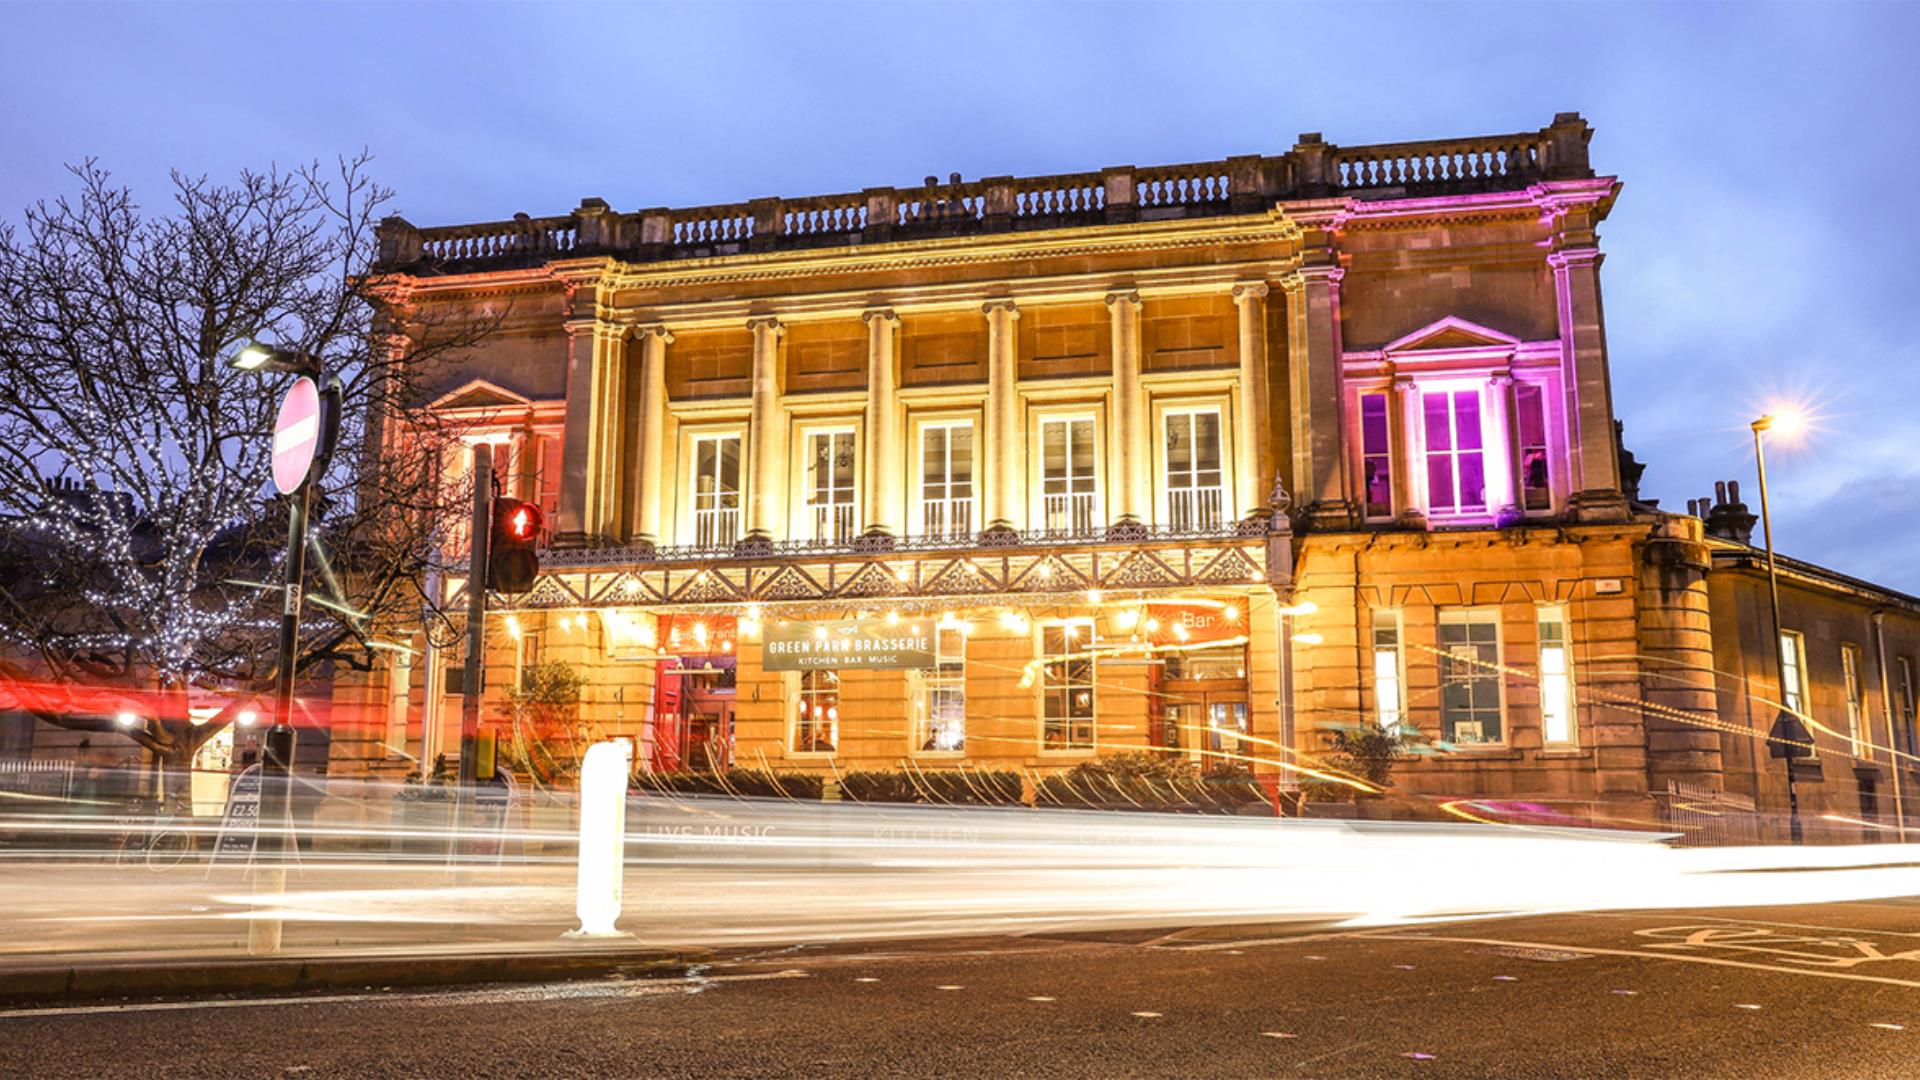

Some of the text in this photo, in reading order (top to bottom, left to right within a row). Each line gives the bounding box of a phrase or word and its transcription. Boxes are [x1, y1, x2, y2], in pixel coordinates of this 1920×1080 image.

[1183, 611, 1216, 628] Bar
[768, 637, 928, 655] GREEN PARK BRASSERIE
[798, 655, 897, 666] KITCHEN BAR MUSIC
[703, 825, 777, 842] MUSIC
[873, 827, 979, 845] KITCHEN
